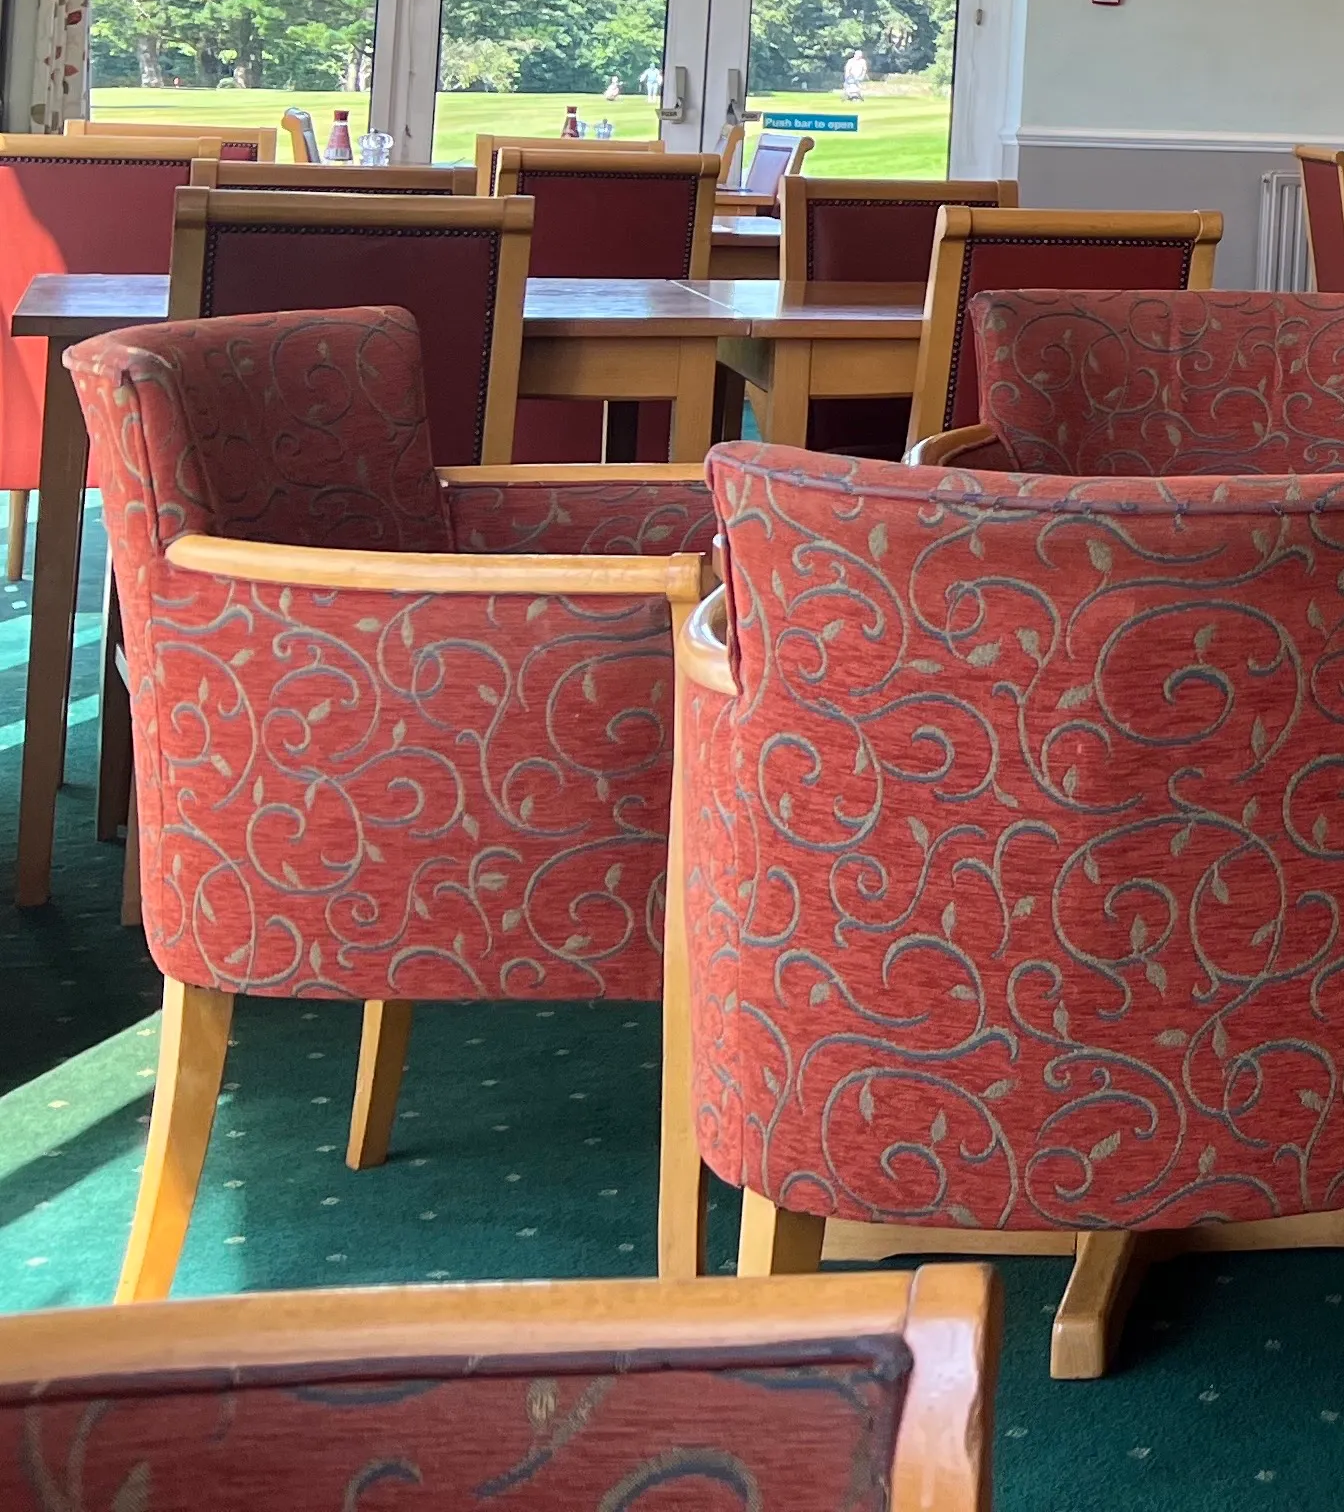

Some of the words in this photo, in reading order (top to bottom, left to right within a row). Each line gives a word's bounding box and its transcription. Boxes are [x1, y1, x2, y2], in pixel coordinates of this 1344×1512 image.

[764, 117, 792, 128] Push
[794, 118, 812, 129] bar
[814, 119, 826, 129] to
[827, 121, 854, 131] open
